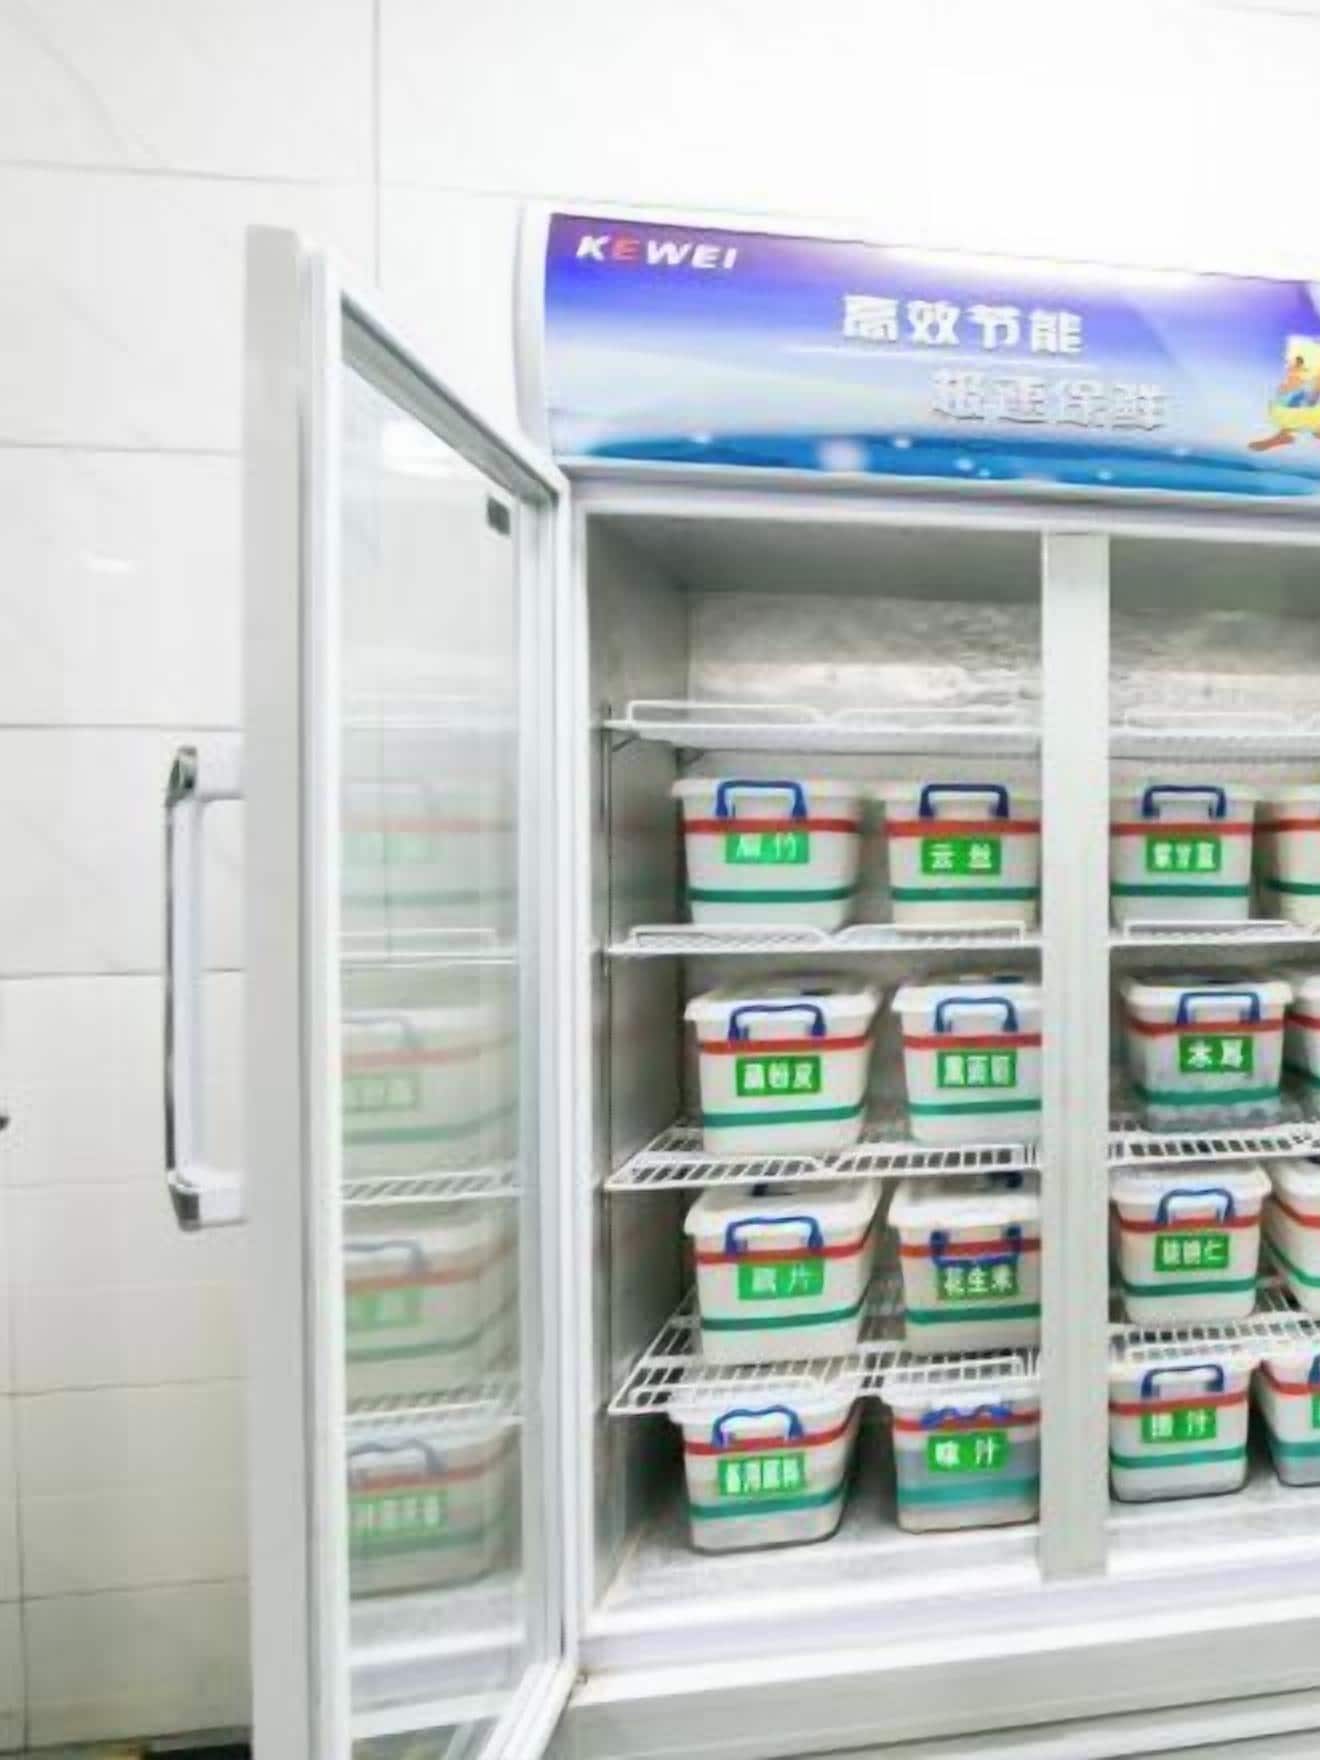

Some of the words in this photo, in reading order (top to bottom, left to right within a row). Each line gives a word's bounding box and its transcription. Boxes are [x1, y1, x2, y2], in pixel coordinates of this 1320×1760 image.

[575, 234, 738, 270] KEWEI
[843, 294, 1083, 354] 高效节能
